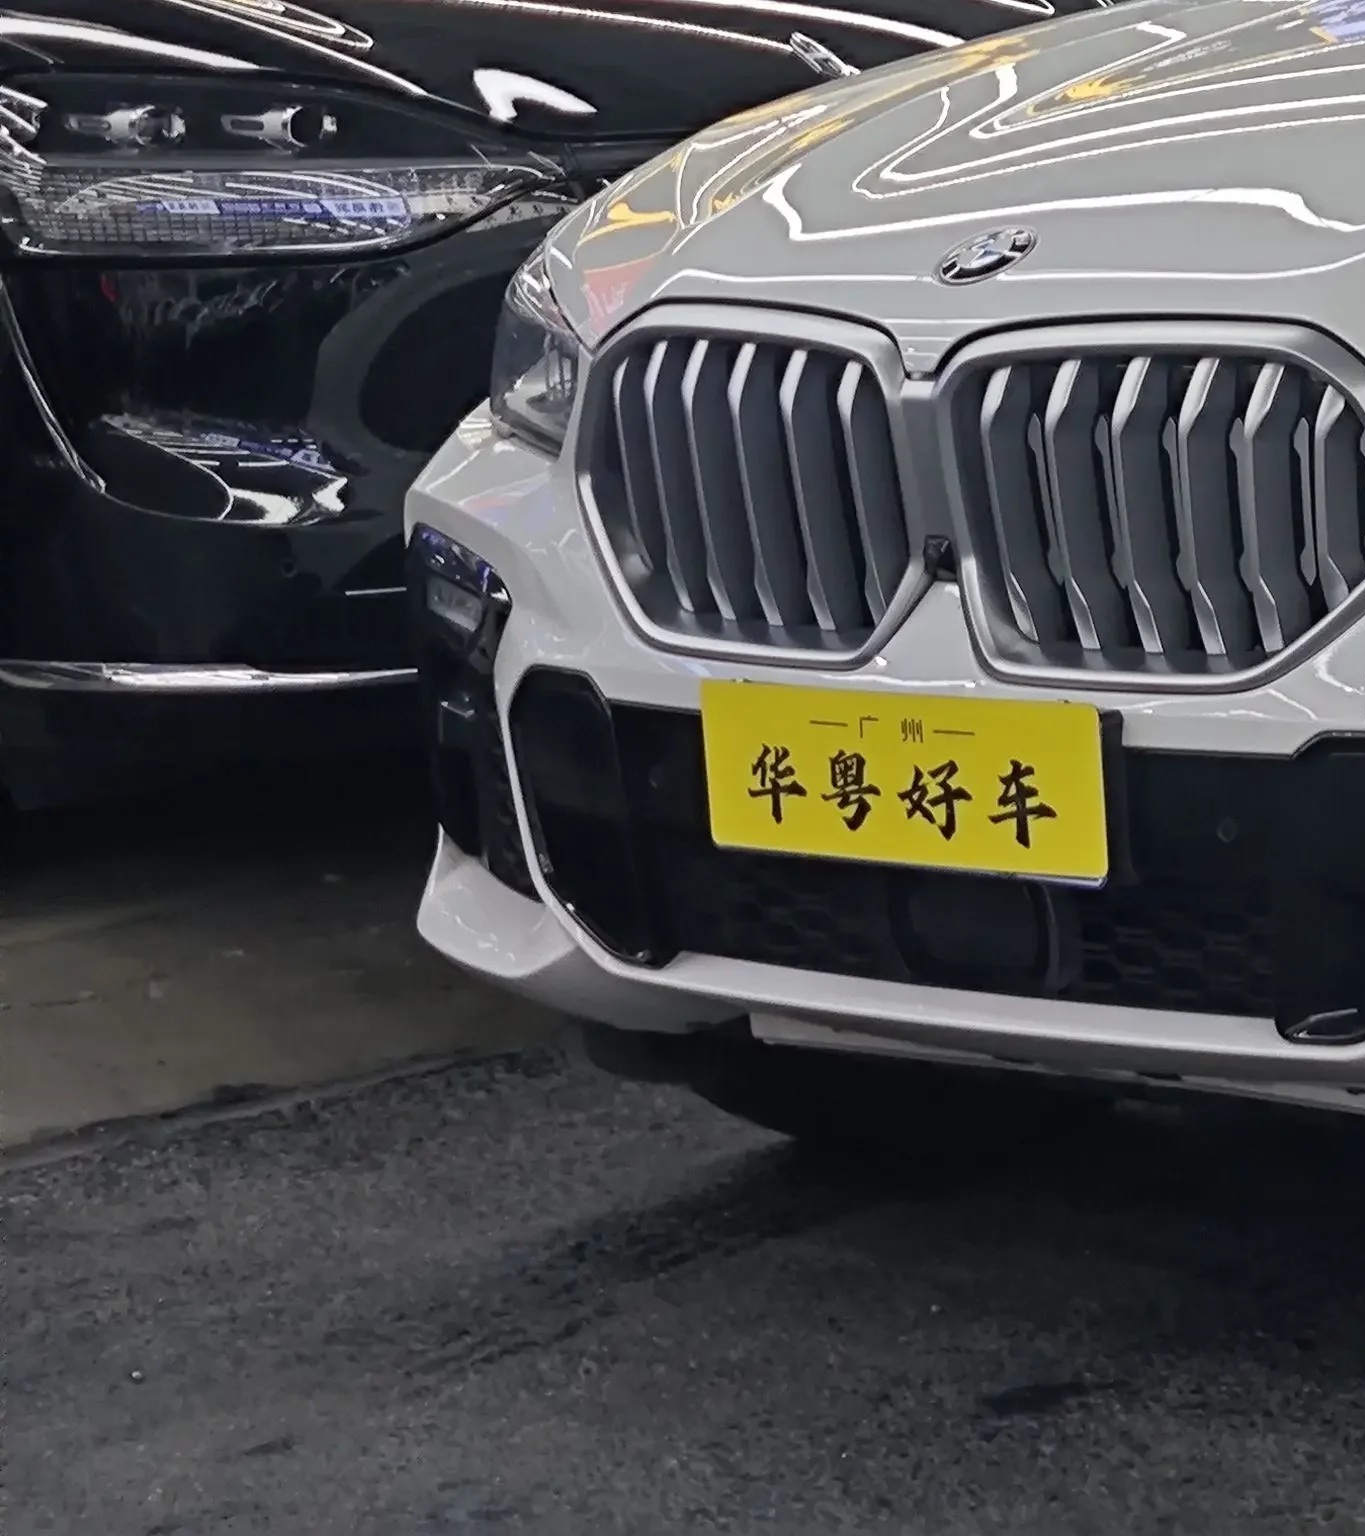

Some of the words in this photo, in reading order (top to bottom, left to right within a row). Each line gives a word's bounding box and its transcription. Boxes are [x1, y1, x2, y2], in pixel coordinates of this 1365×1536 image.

[859, 716, 924, 743] 广州
[748, 743, 1057, 849] 华粤好车
